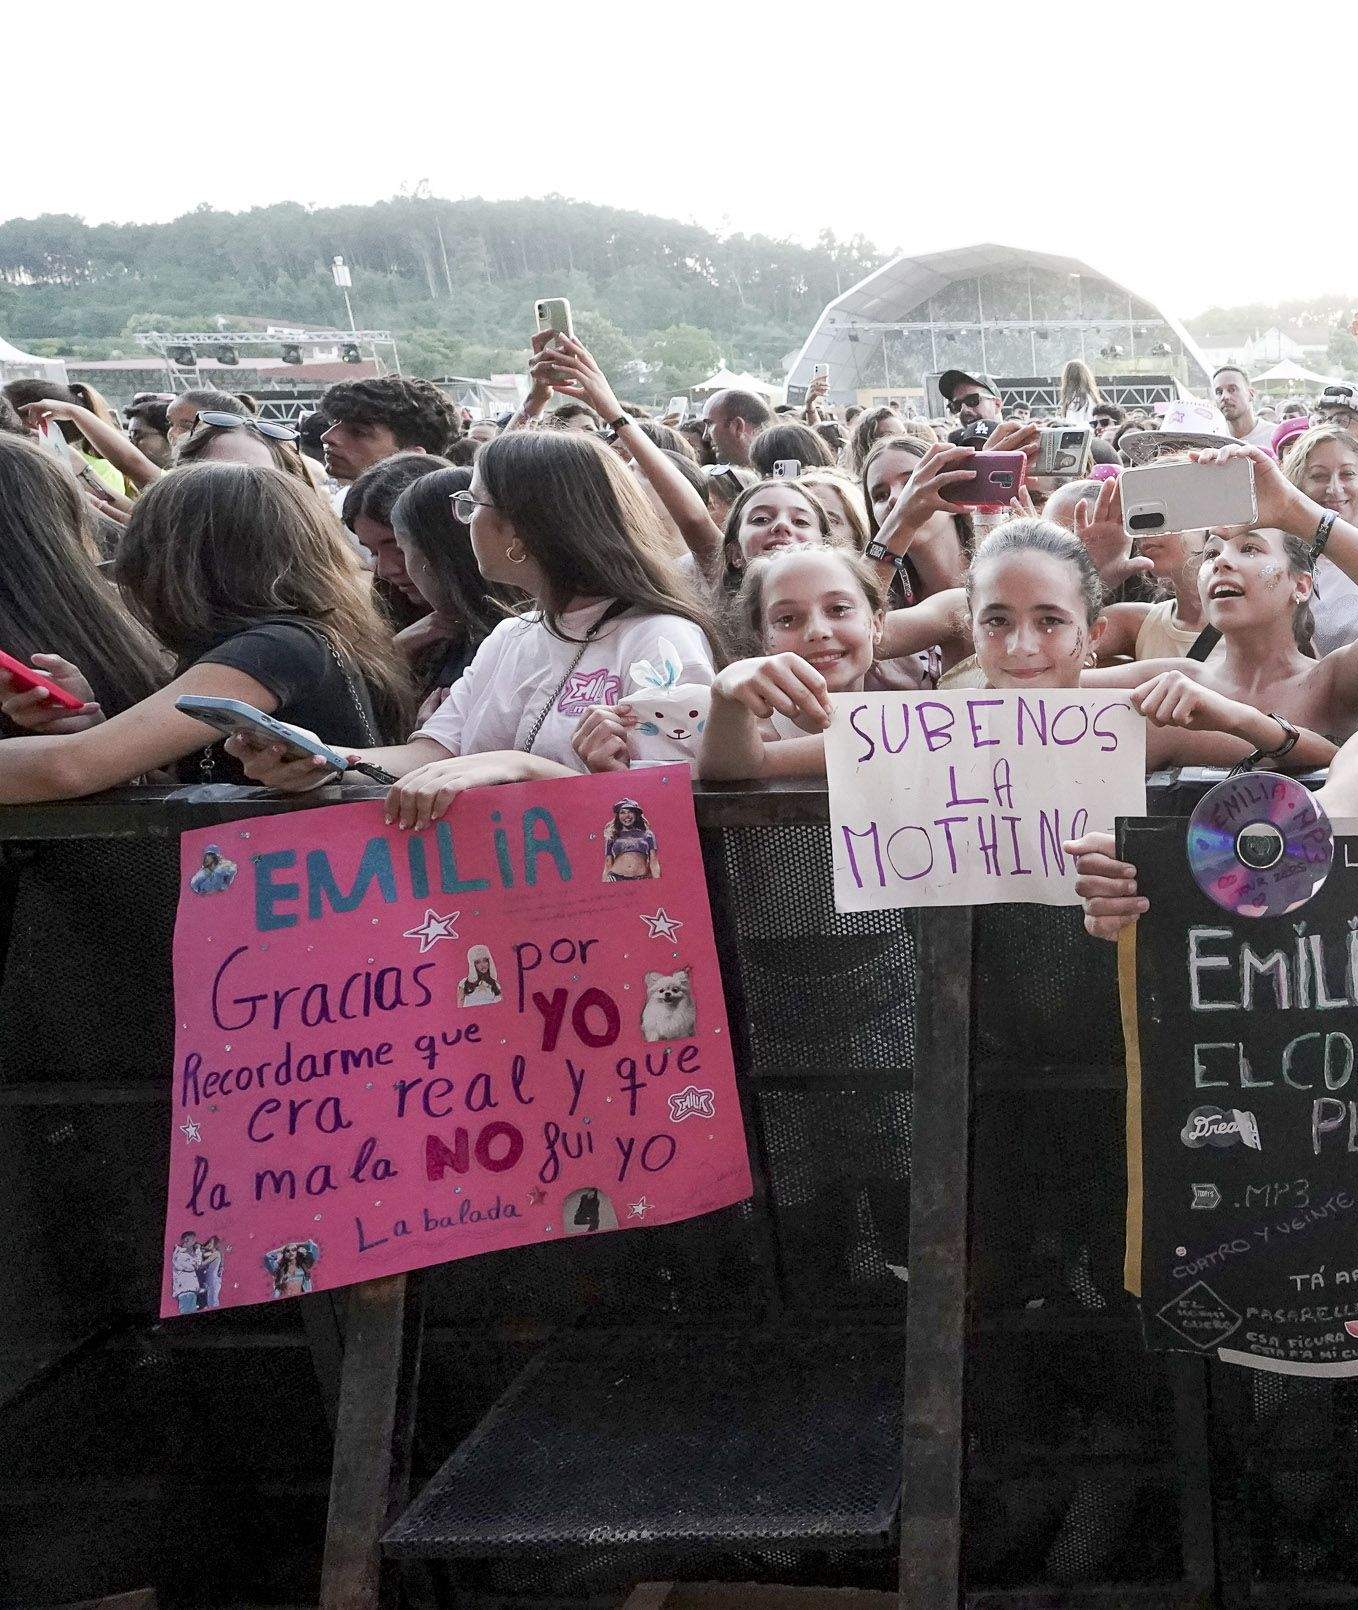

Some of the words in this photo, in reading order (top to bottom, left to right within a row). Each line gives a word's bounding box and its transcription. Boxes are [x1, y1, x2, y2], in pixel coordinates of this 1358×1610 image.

[850, 697, 1130, 762] SUBENOS
[945, 758, 1013, 808] LA
[212, 945, 437, 1031] Gracias
[514, 936, 599, 1013] por
[182, 1039, 393, 1107] Recordarme
[415, 1022, 482, 1068] que
[532, 986, 621, 1051] YO
[1194, 1042, 1274, 1089] EL
[247, 1089, 352, 1142] era
[396, 1055, 535, 1118] real
[616, 1044, 701, 1116] que
[186, 1156, 231, 1216] la
[425, 1120, 524, 1181] NO
[539, 1119, 594, 1183] fui
[355, 1215, 411, 1254] La
[423, 1200, 523, 1231] balada
[1289, 1265, 1326, 1290] TÁ
